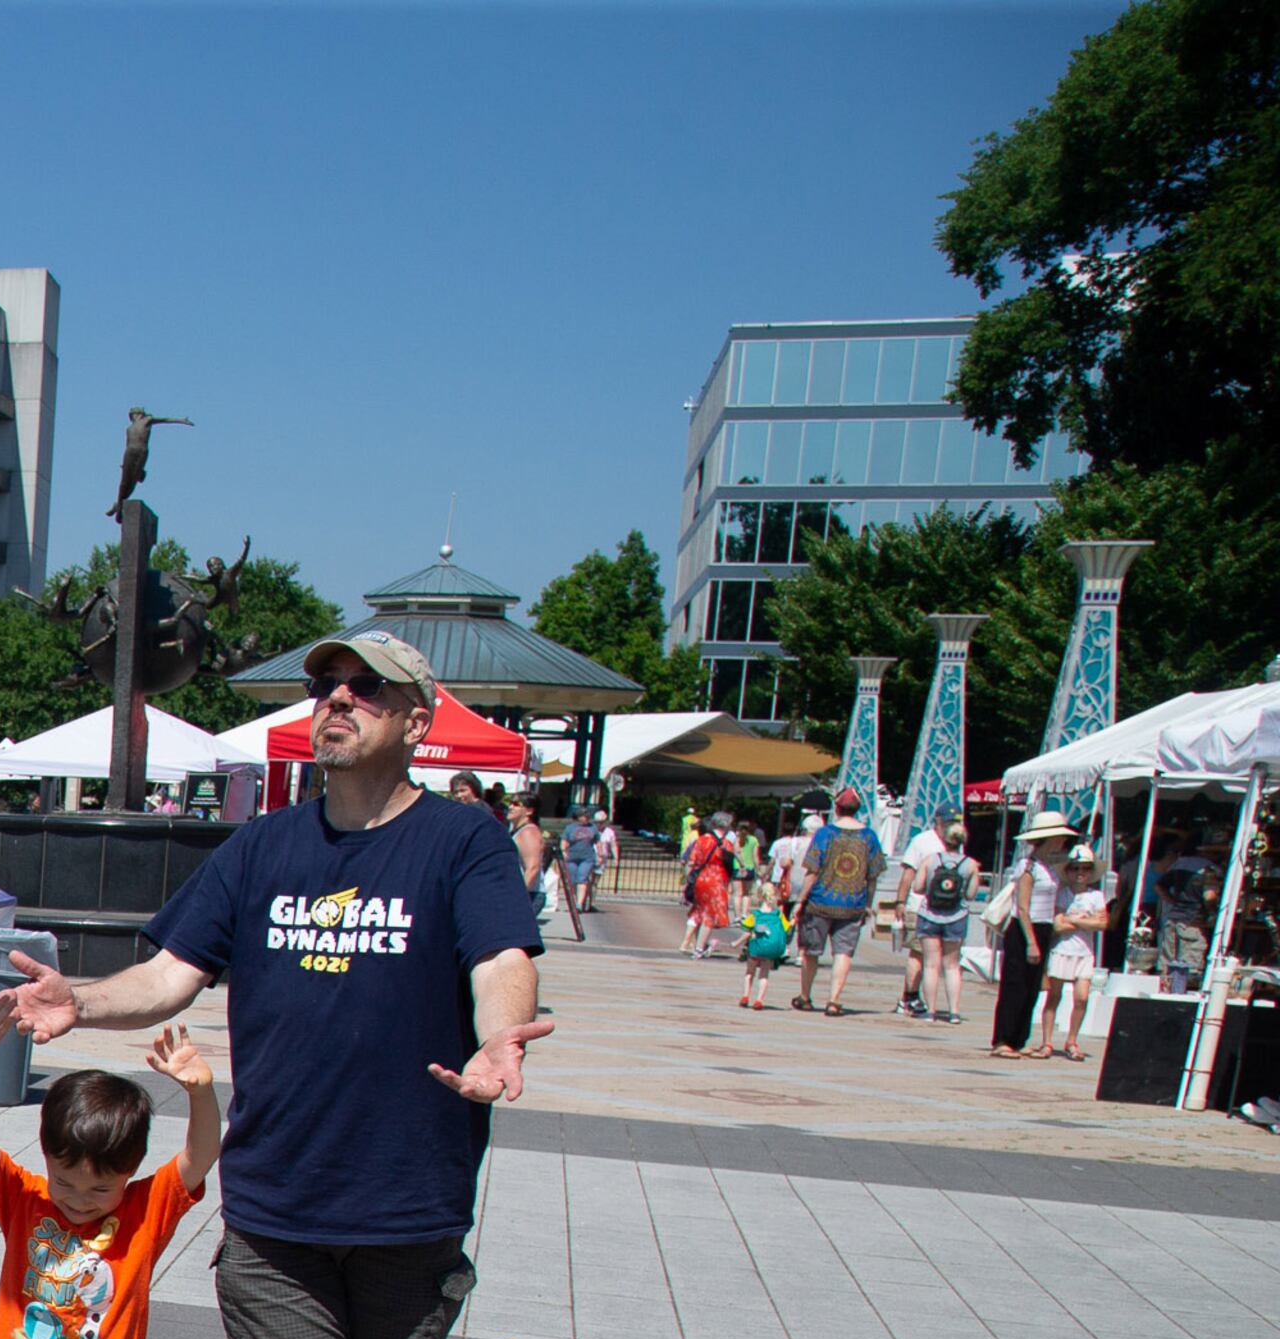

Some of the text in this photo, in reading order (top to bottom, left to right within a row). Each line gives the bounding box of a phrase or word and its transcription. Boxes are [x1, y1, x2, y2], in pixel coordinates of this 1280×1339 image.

[413, 743, 449, 759] arm
[269, 890, 413, 928] GLOBAL
[266, 928, 408, 954] DYNAMICS
